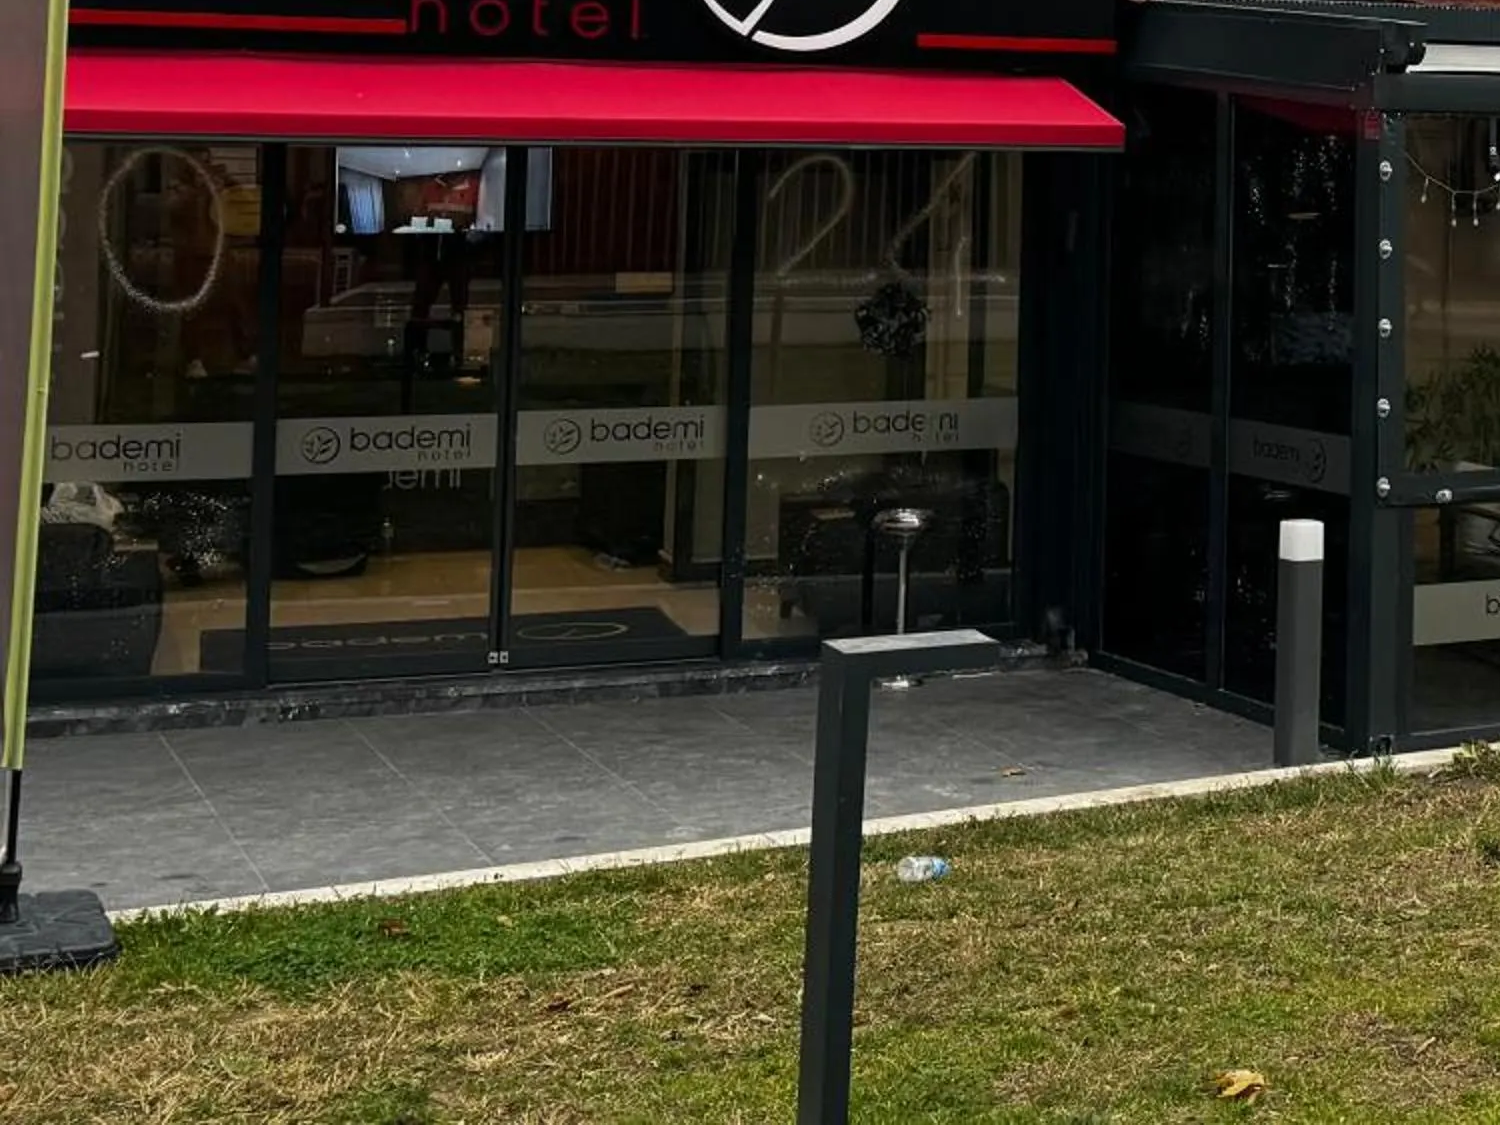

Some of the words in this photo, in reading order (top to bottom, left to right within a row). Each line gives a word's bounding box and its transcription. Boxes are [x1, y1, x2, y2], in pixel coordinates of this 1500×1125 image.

[350, 423, 472, 452] bademi
[590, 415, 704, 442] bademi
[51, 432, 182, 461] bademi
